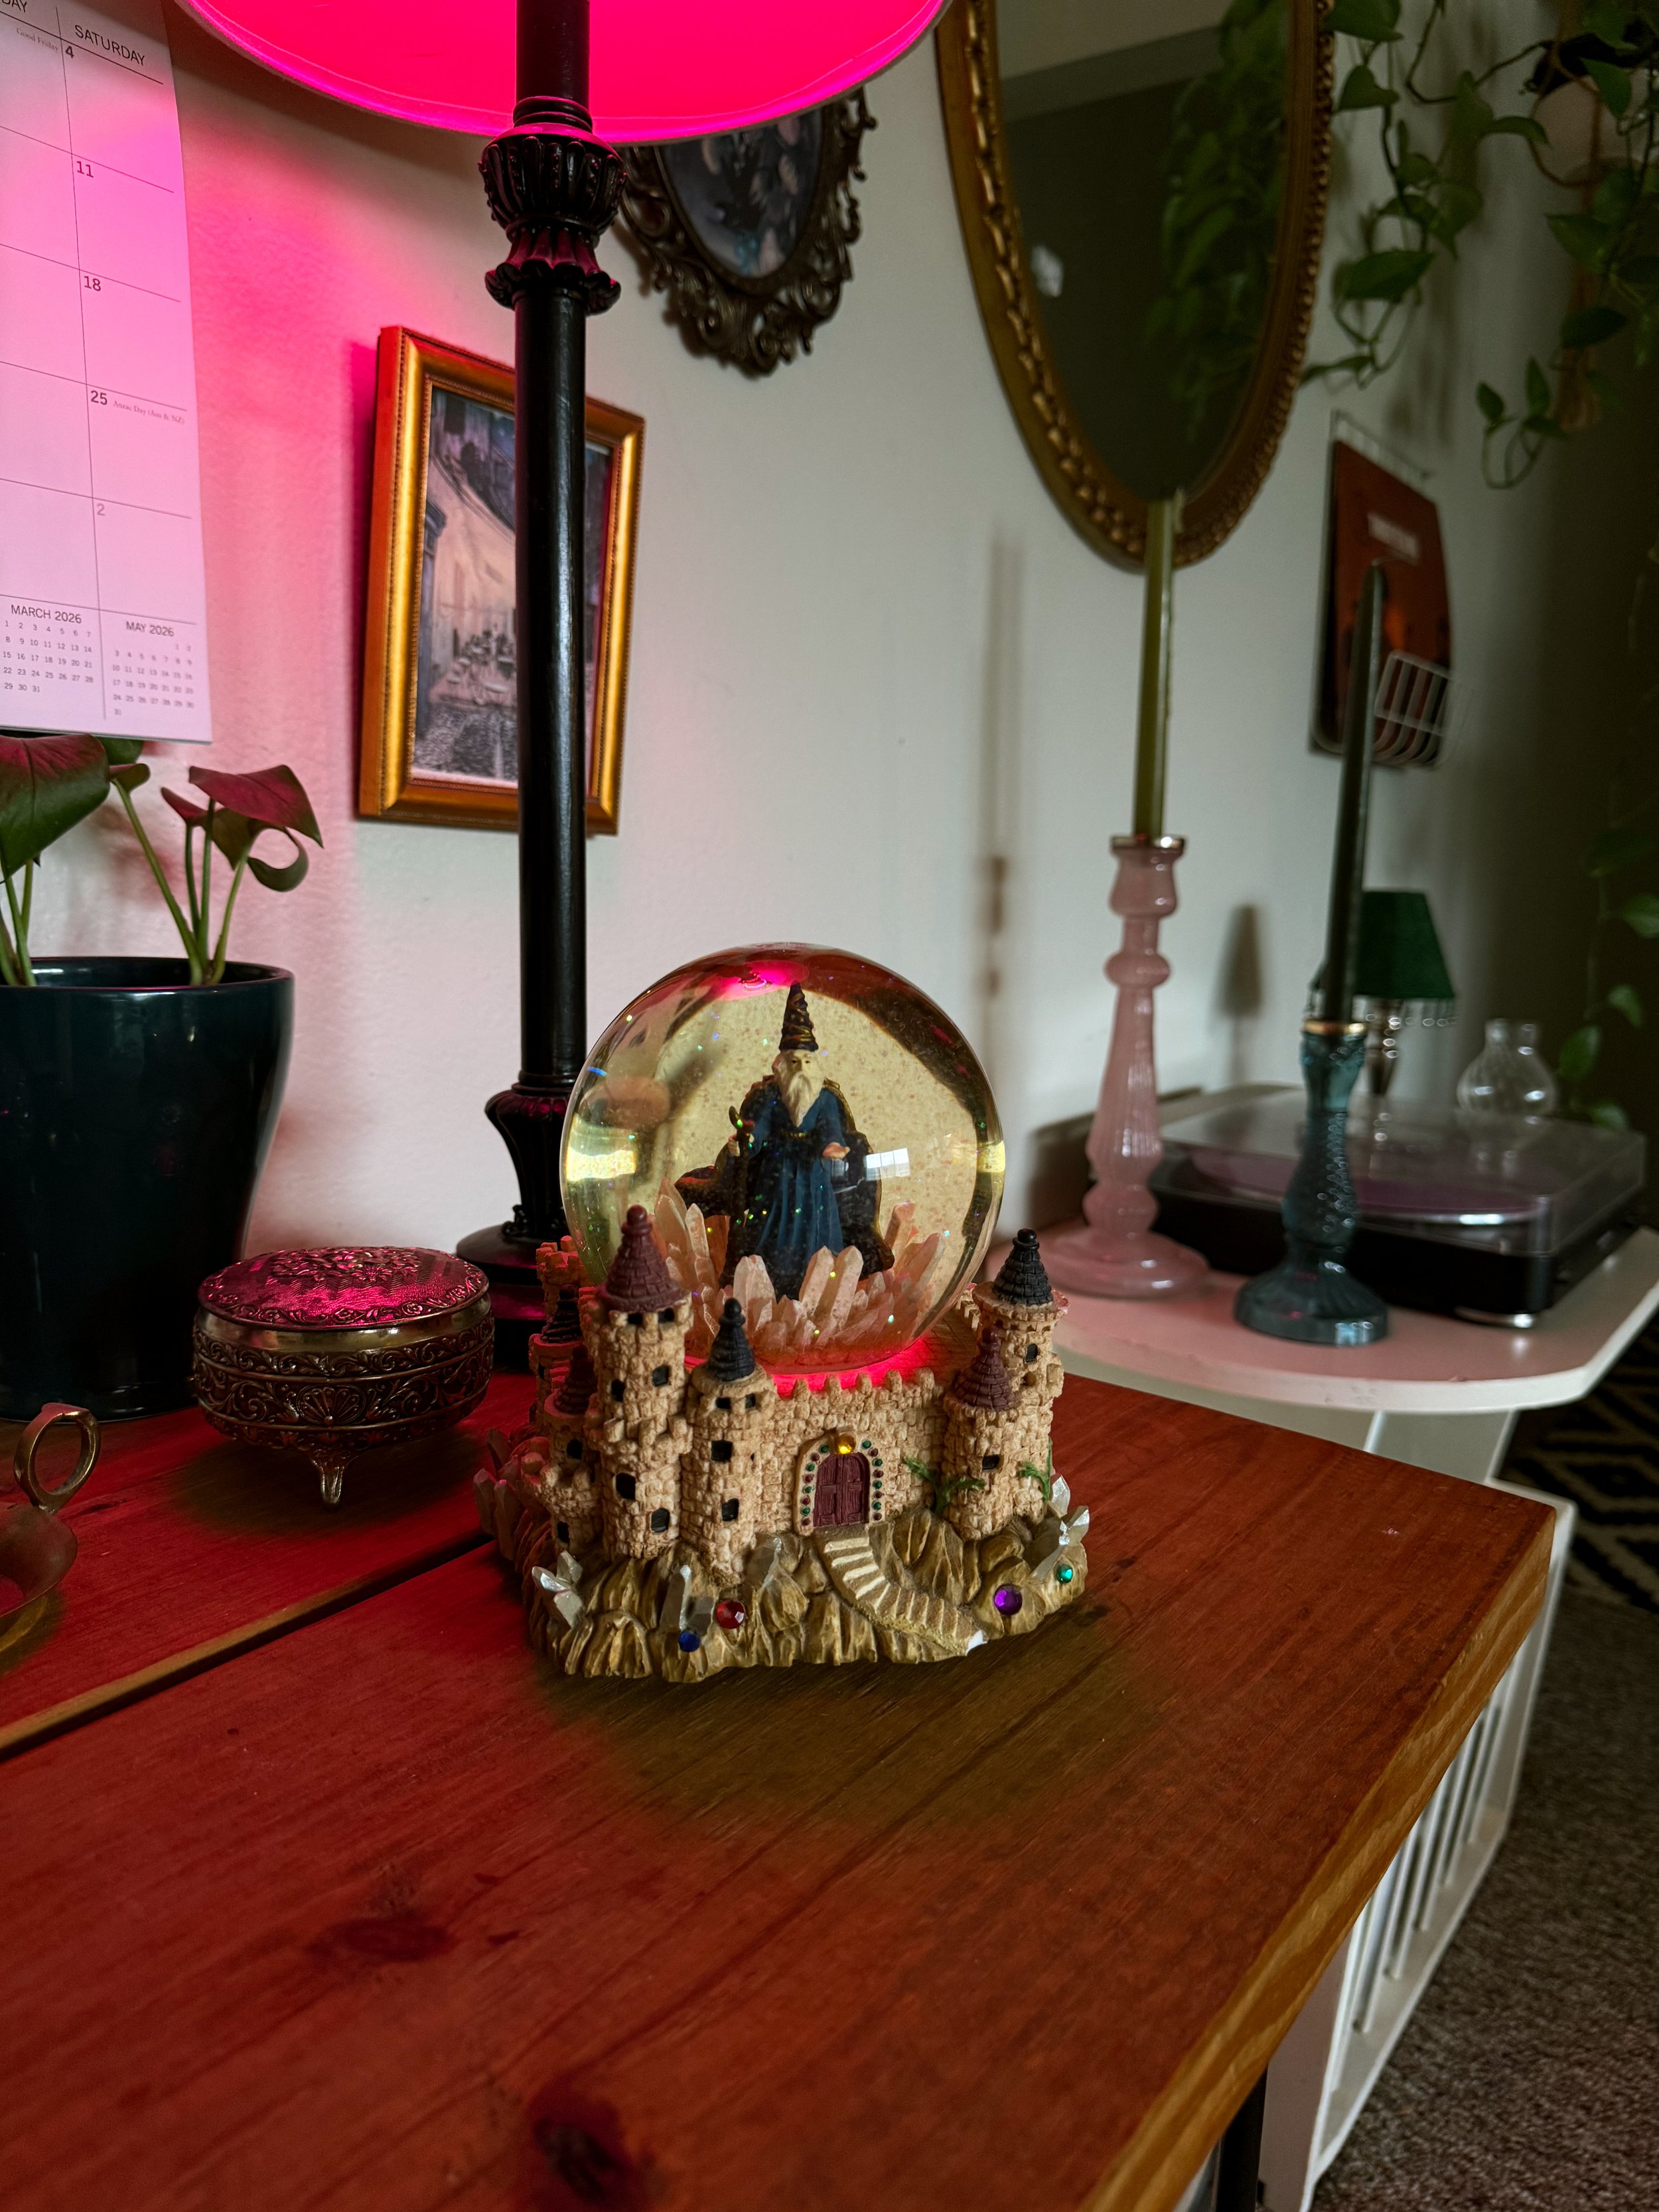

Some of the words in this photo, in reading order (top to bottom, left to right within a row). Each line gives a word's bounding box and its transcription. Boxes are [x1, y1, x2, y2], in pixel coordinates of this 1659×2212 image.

[65, 45, 74, 58] 4
[75, 25, 145, 66] SATURDAY
[76, 161, 94, 178] 11
[84, 275, 102, 291] 18
[90, 390, 108, 406] 25
[97, 503, 106, 516] 2
[11, 605, 51, 619] MARCH
[54, 611, 82, 624] 2026
[126, 621, 147, 632] MAY
[149, 625, 175, 636] 2026
